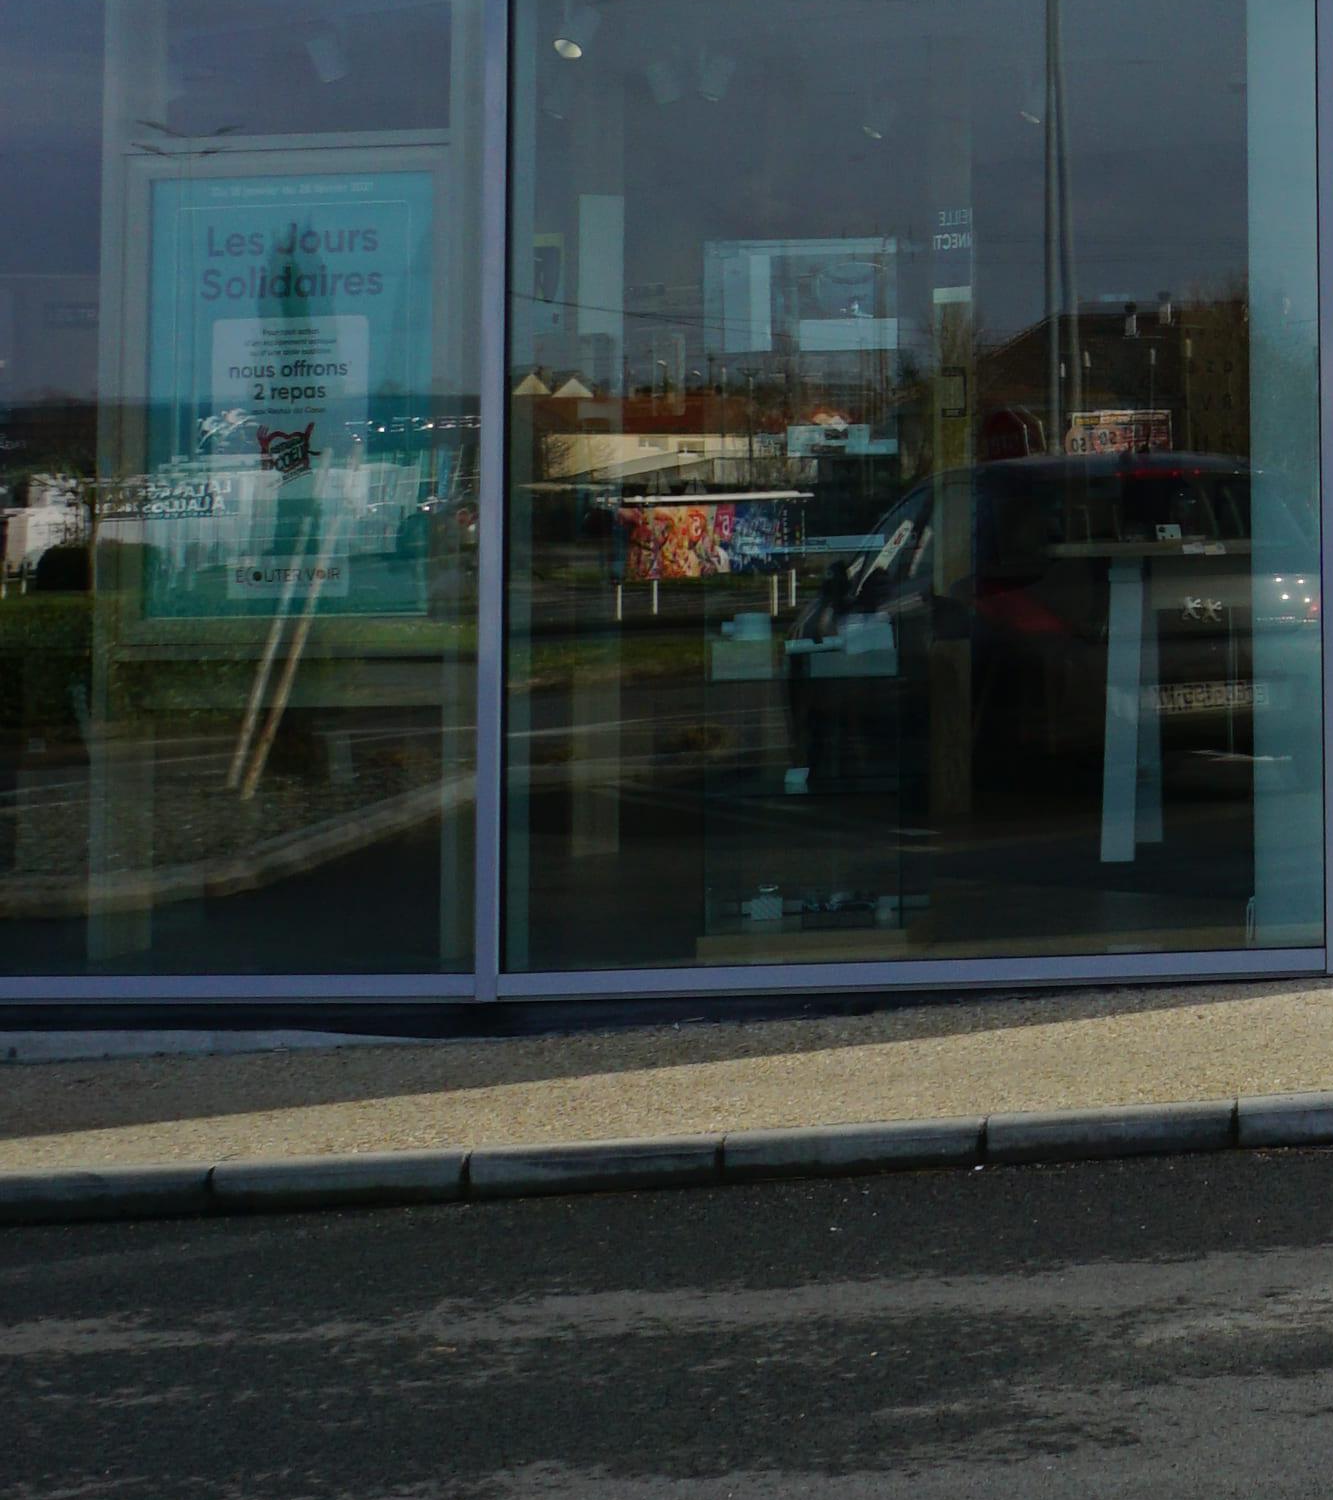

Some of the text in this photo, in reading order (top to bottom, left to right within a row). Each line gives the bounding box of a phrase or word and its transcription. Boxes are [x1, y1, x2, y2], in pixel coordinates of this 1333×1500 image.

[207, 222, 379, 257] Les Jours
[200, 263, 384, 301] Solidaires
[228, 363, 275, 379] nous
[253, 382, 326, 405] 2 repas
[305, 567, 341, 583] VOIR
